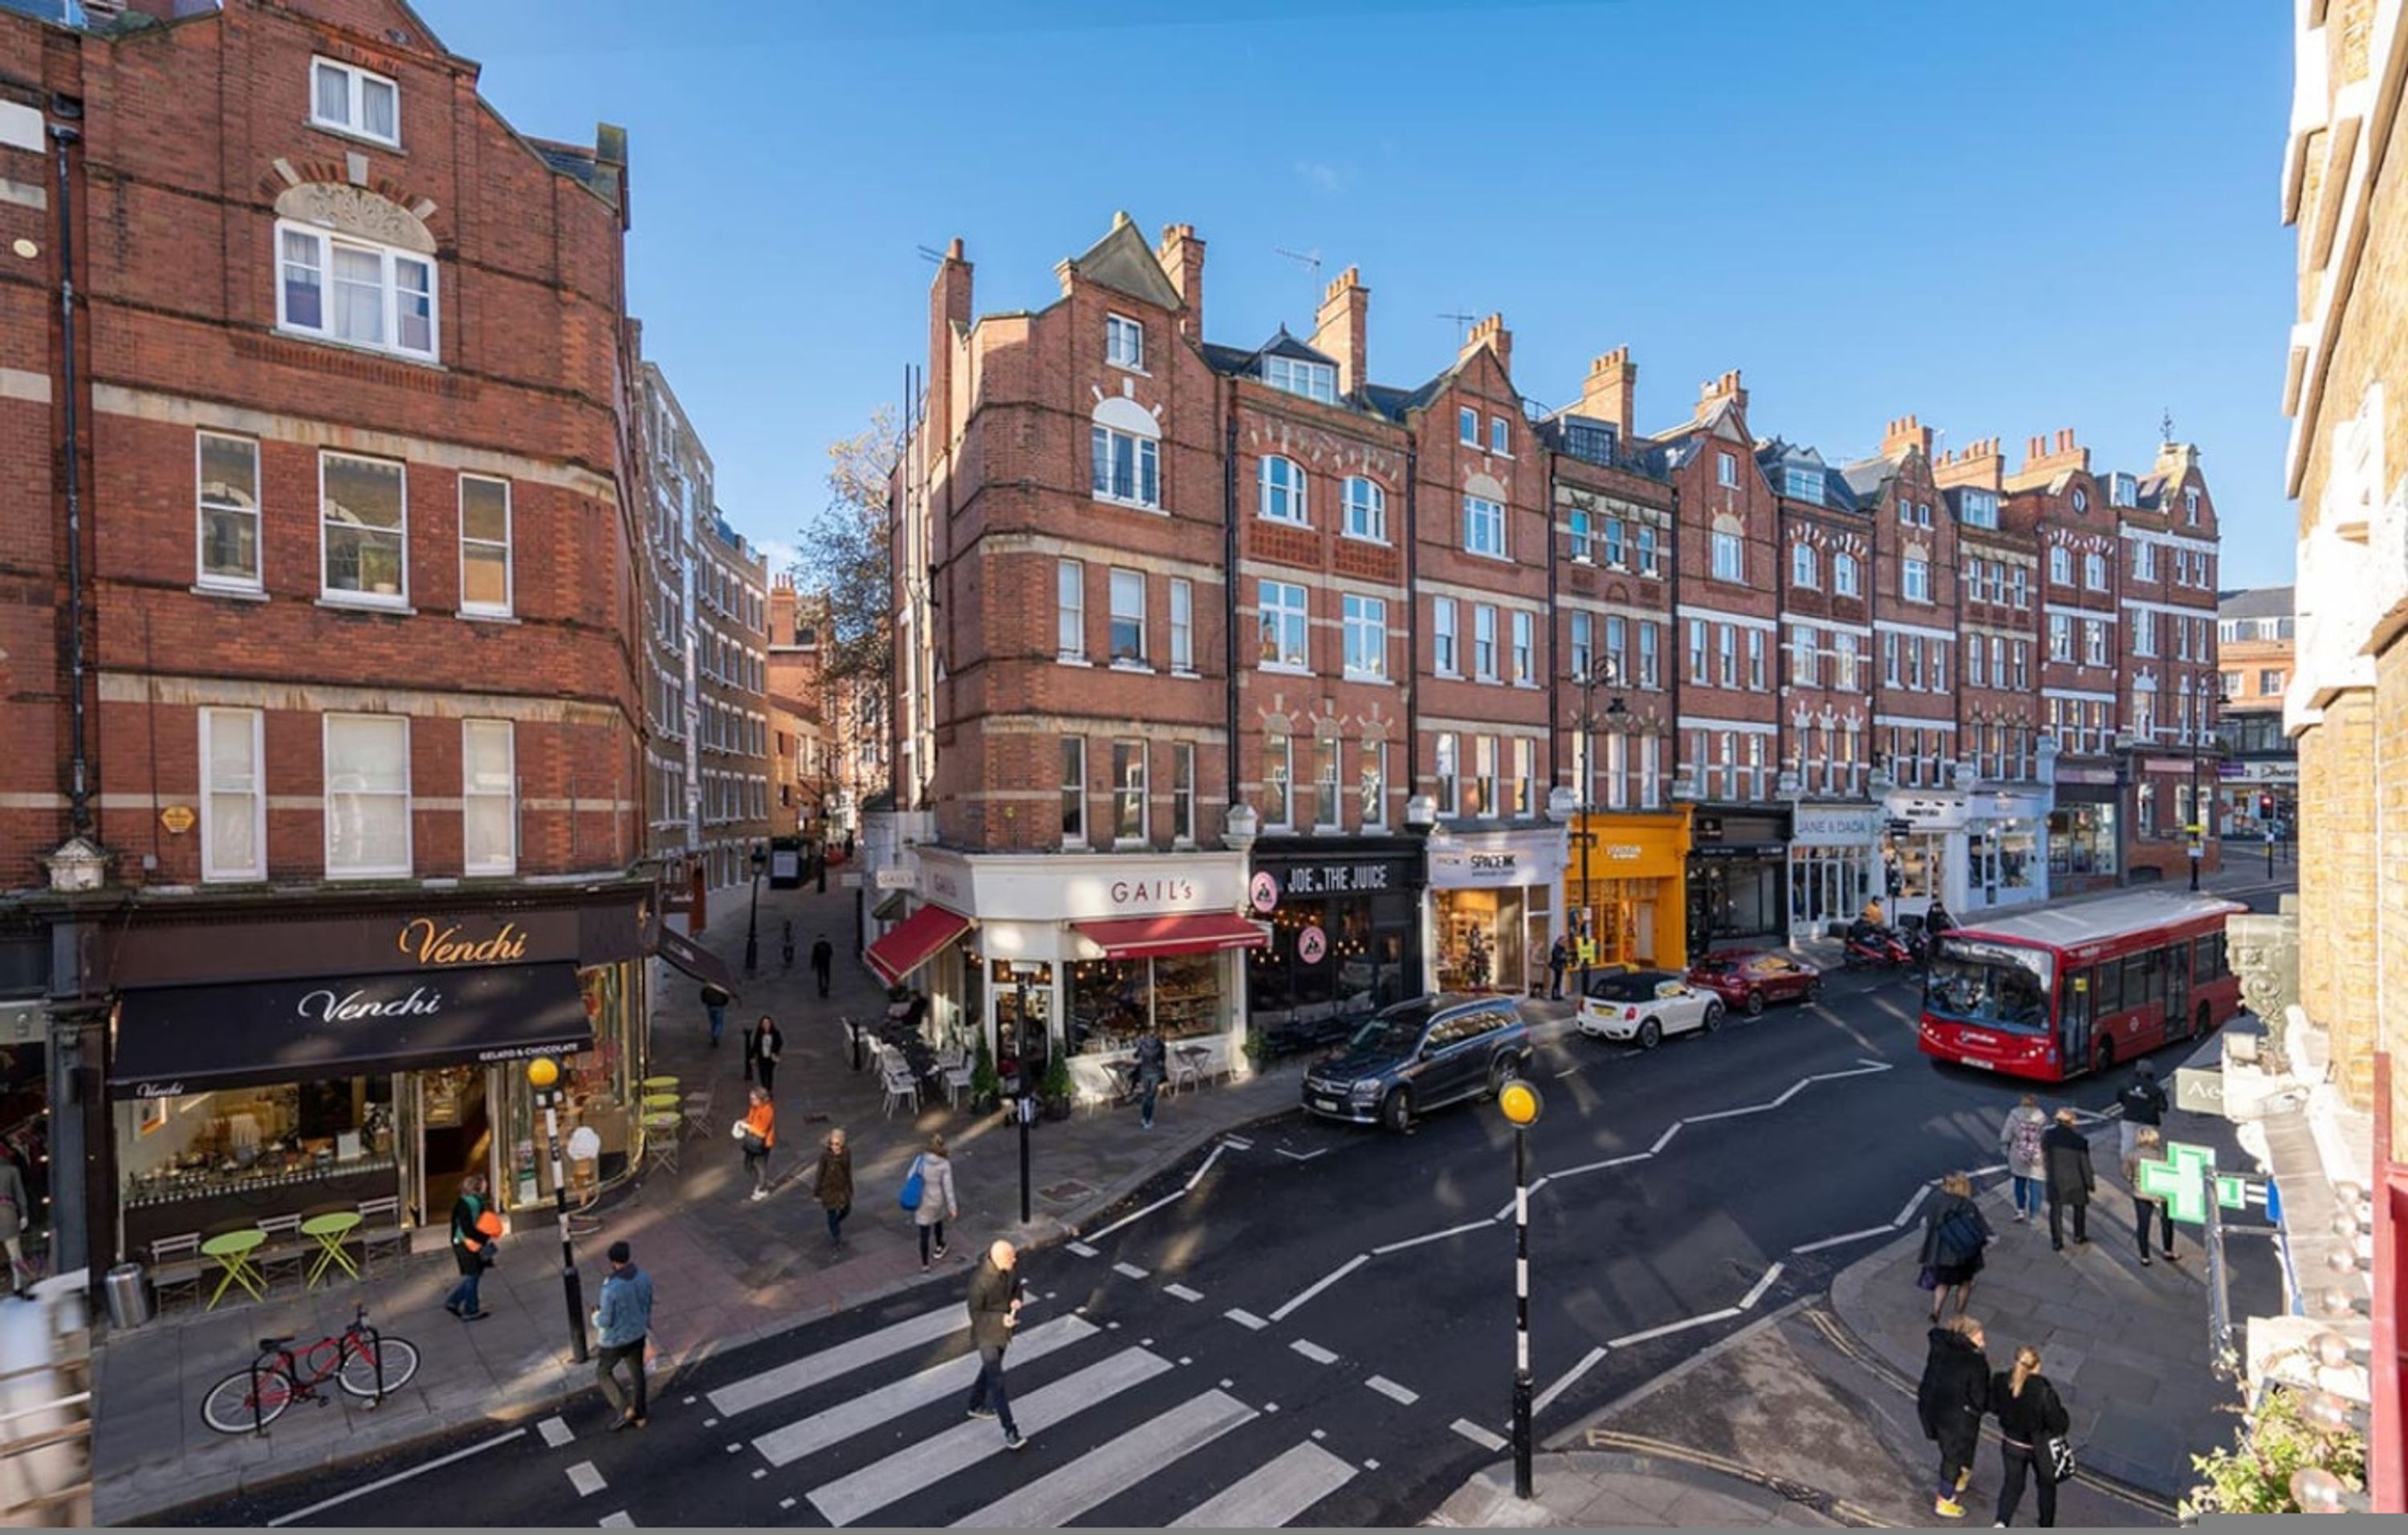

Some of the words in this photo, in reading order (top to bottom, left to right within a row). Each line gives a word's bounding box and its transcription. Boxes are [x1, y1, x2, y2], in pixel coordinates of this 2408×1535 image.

[1111, 880, 1193, 904] GAIL's
[1287, 868, 1313, 893] JOE
[1323, 866, 1348, 890] THE
[1351, 865, 1387, 890] JUICE
[399, 918, 527, 963] Venchi
[298, 987, 441, 1023] Venchi
[479, 1048, 515, 1061] GELATO
[524, 1043, 578, 1056] CHOCOLATE
